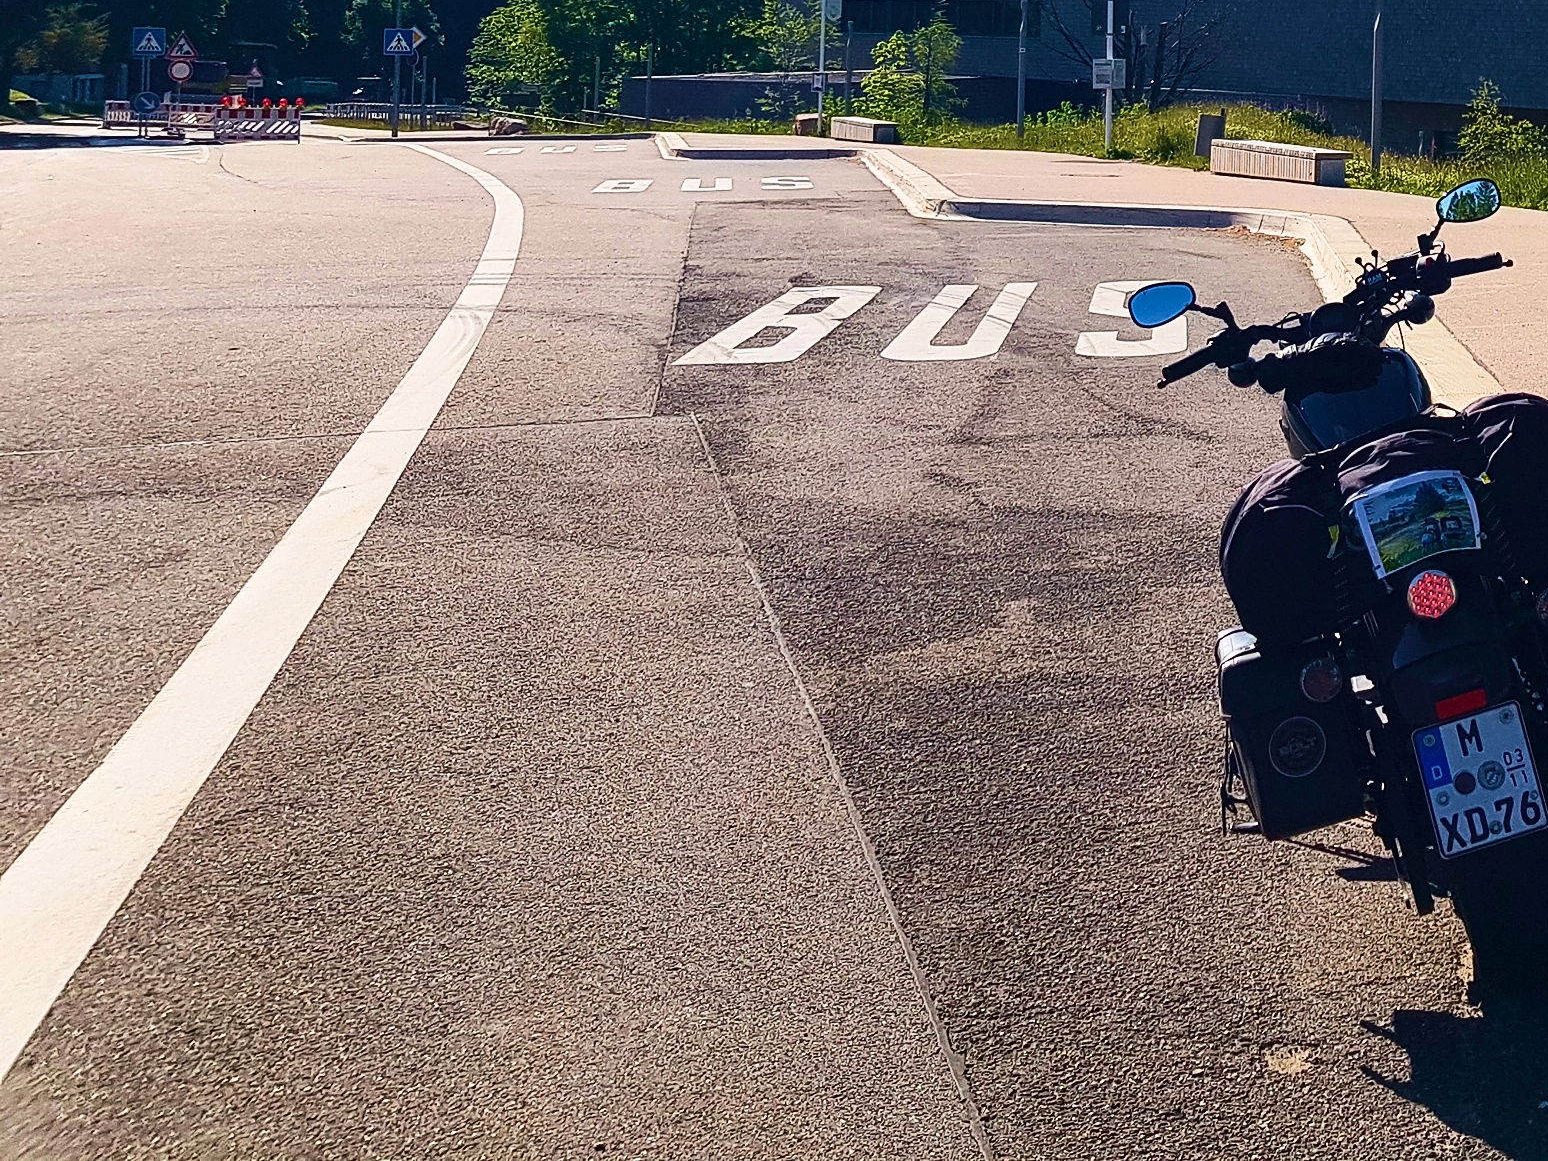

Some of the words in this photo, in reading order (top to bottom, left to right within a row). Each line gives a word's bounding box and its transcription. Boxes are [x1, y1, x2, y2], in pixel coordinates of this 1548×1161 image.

[484, 144, 628, 156] BUS
[591, 176, 815, 194] BUS
[672, 281, 1188, 365] BUS
[1455, 718, 1484, 757] M
[1503, 748, 1524, 766] 03
[1431, 765, 1443, 781] D
[1510, 770, 1528, 787] 11
[1439, 806, 1490, 853] XD
[1494, 790, 1542, 834] 76
